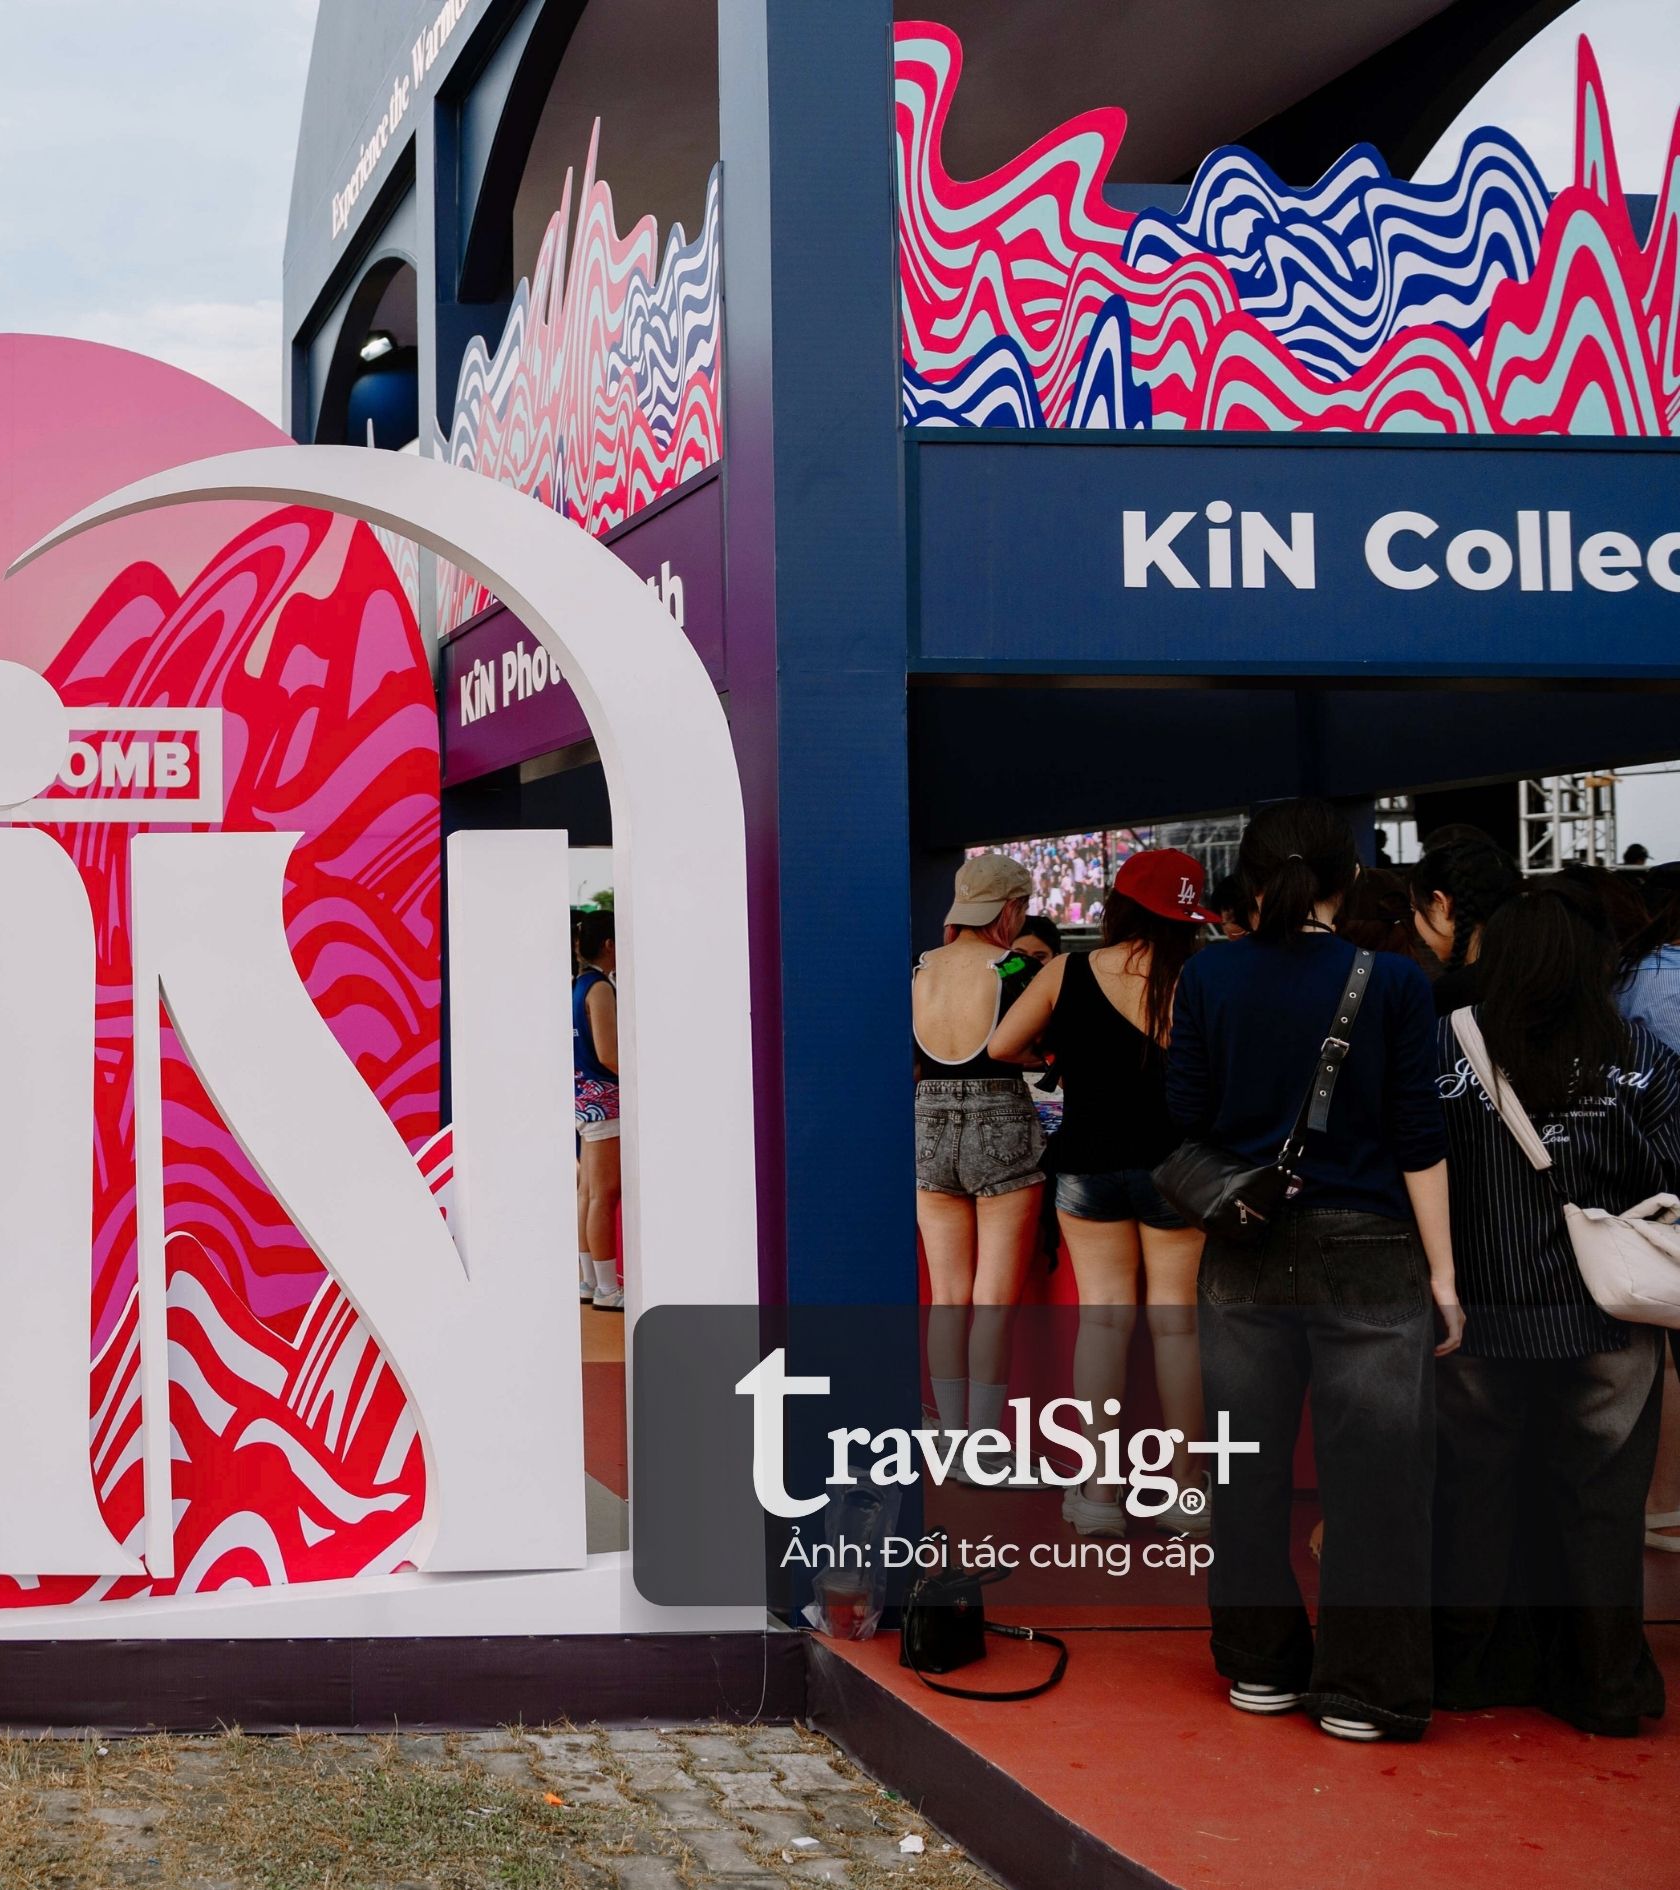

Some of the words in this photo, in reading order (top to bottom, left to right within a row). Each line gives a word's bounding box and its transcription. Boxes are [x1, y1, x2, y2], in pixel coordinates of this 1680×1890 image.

[332, 113, 389, 240] Experience
[389, 75, 410, 135] the
[1123, 500, 1315, 589] KiN
[1177, 877, 1195, 904] LA
[1540, 1124, 1570, 1144] Love
